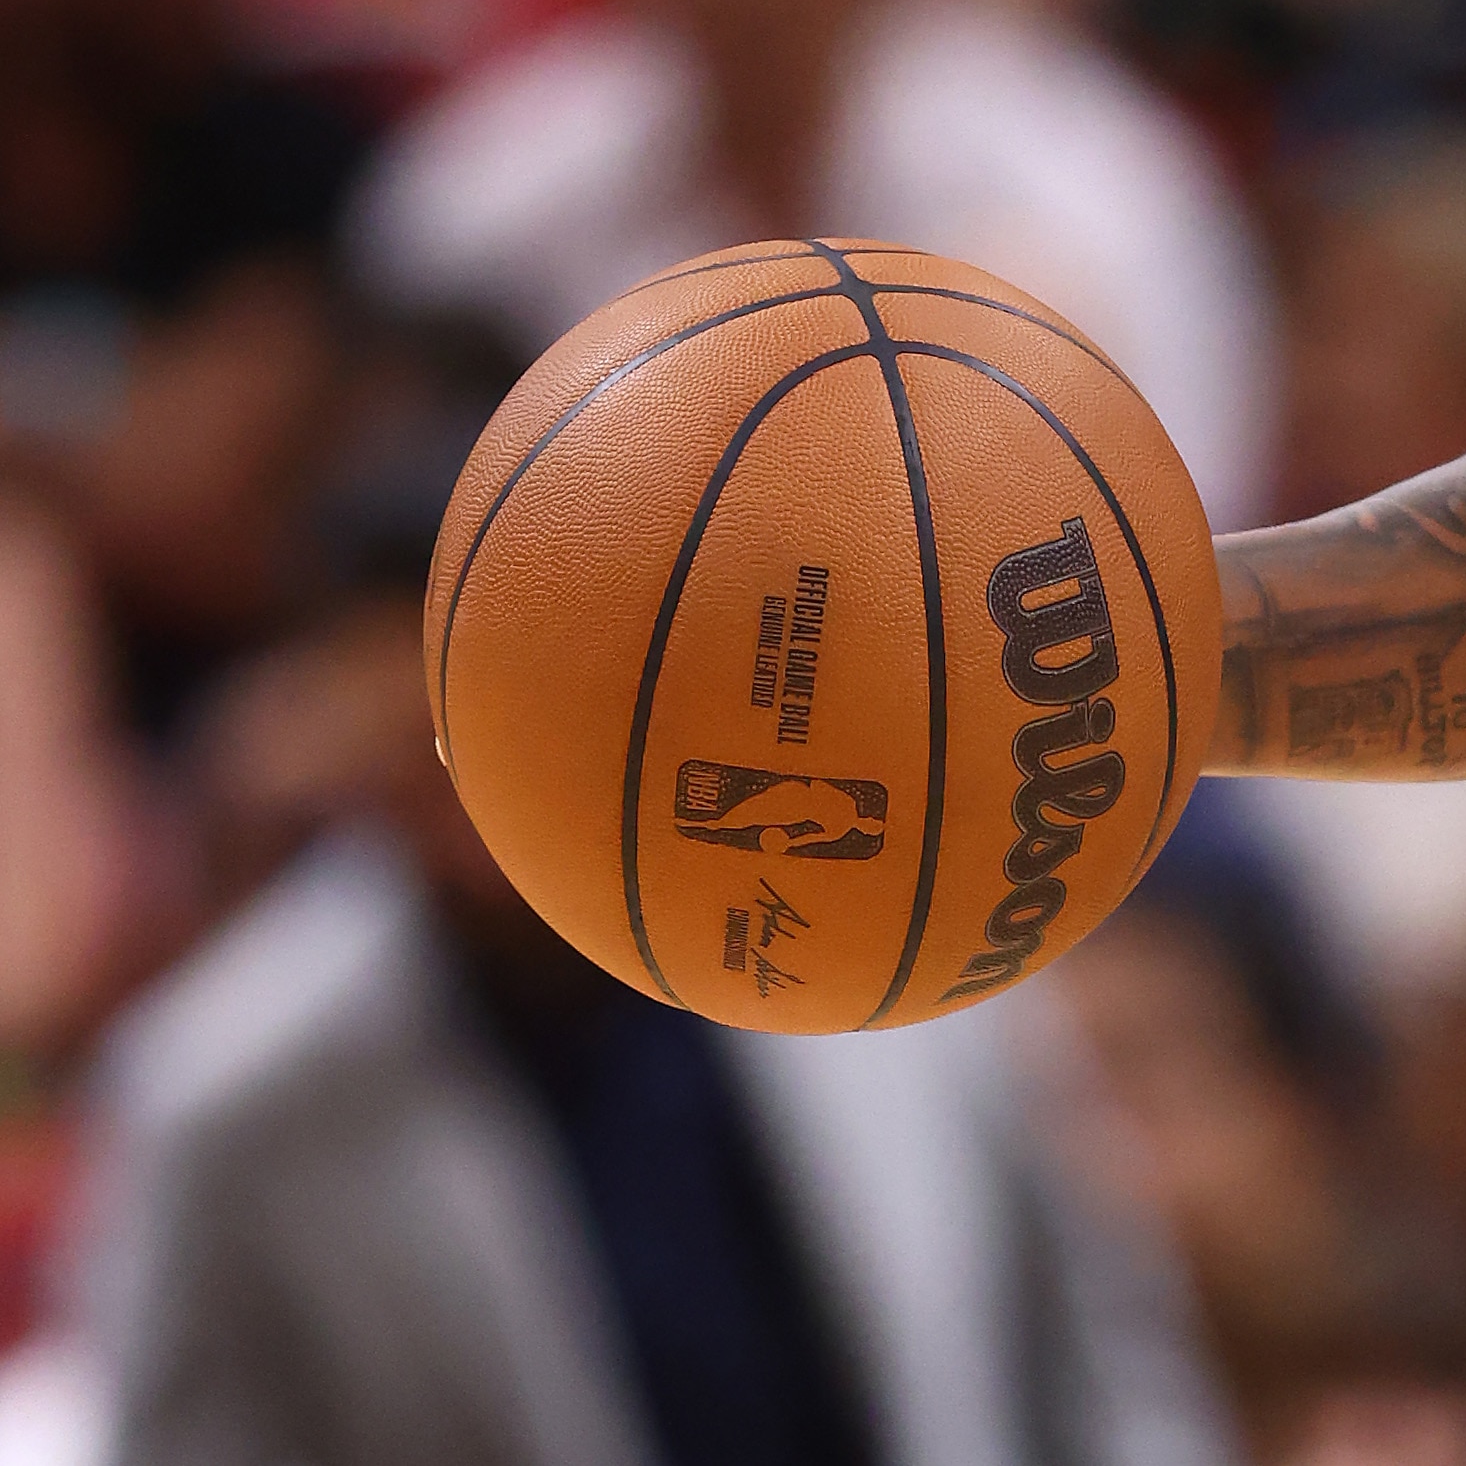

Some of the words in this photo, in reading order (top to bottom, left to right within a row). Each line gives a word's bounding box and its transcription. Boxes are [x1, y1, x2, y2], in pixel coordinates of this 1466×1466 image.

[757, 595, 788, 650] GENUINE
[789, 565, 830, 644] OFFICIAL
[782, 648, 818, 701] GAME
[777, 702, 811, 746] BALL
[935, 514, 1127, 1004] Wilson
[686, 769, 721, 812] NBA
